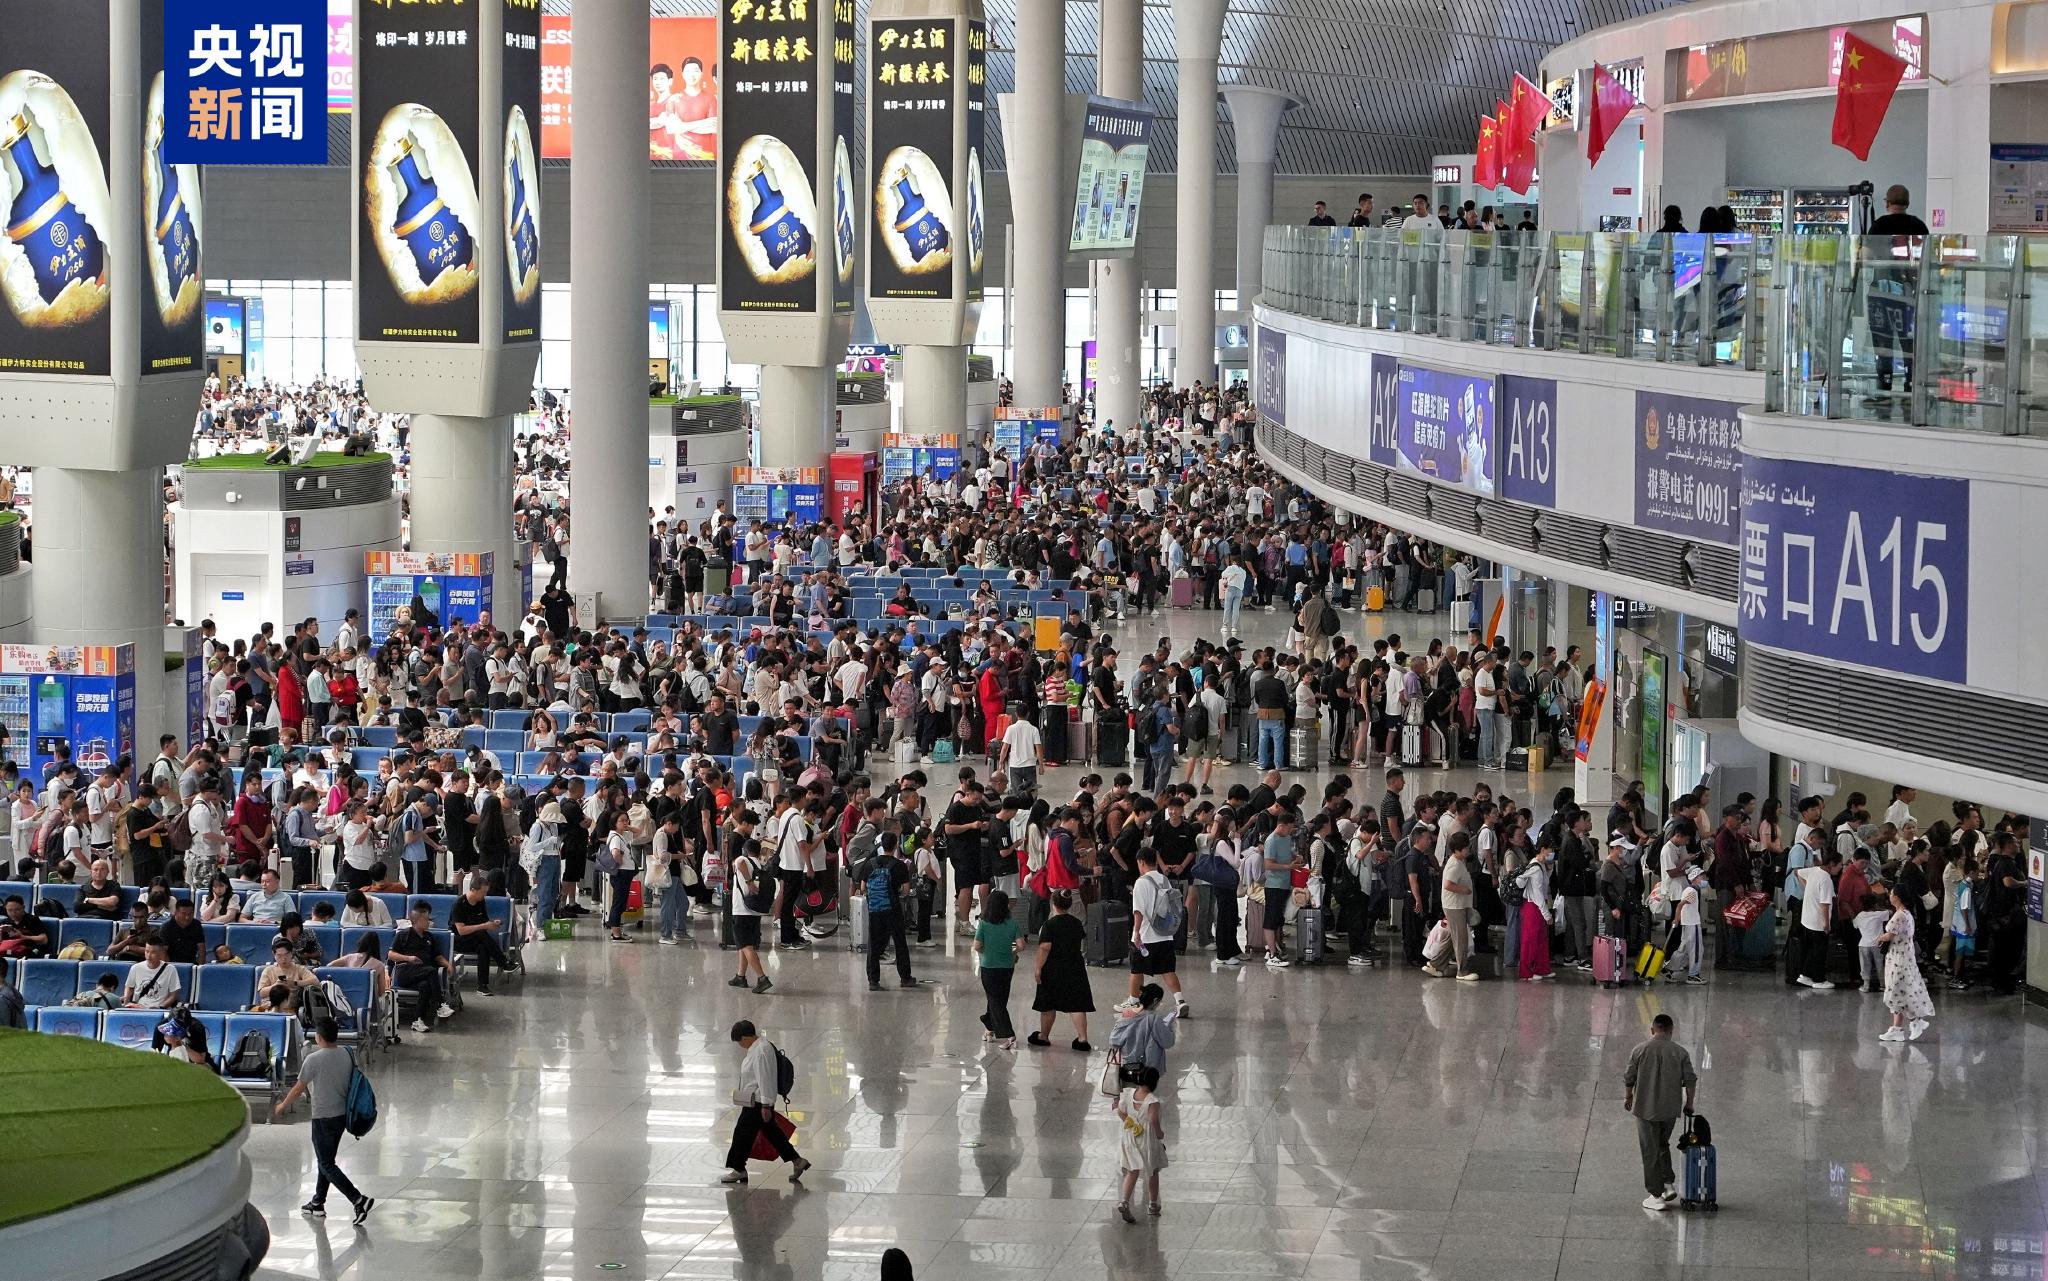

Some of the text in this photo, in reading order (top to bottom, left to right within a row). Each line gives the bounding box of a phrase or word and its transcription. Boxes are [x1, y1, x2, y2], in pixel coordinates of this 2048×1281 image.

[847, 345, 876, 355] vivo
[1414, 420, 1446, 451] 提高免疫力
[1507, 396, 1551, 485] A13
[1647, 467, 1694, 506] 报警电话
[1829, 510, 1949, 654] A15
[76, 703, 110, 713] 劲爽无限
